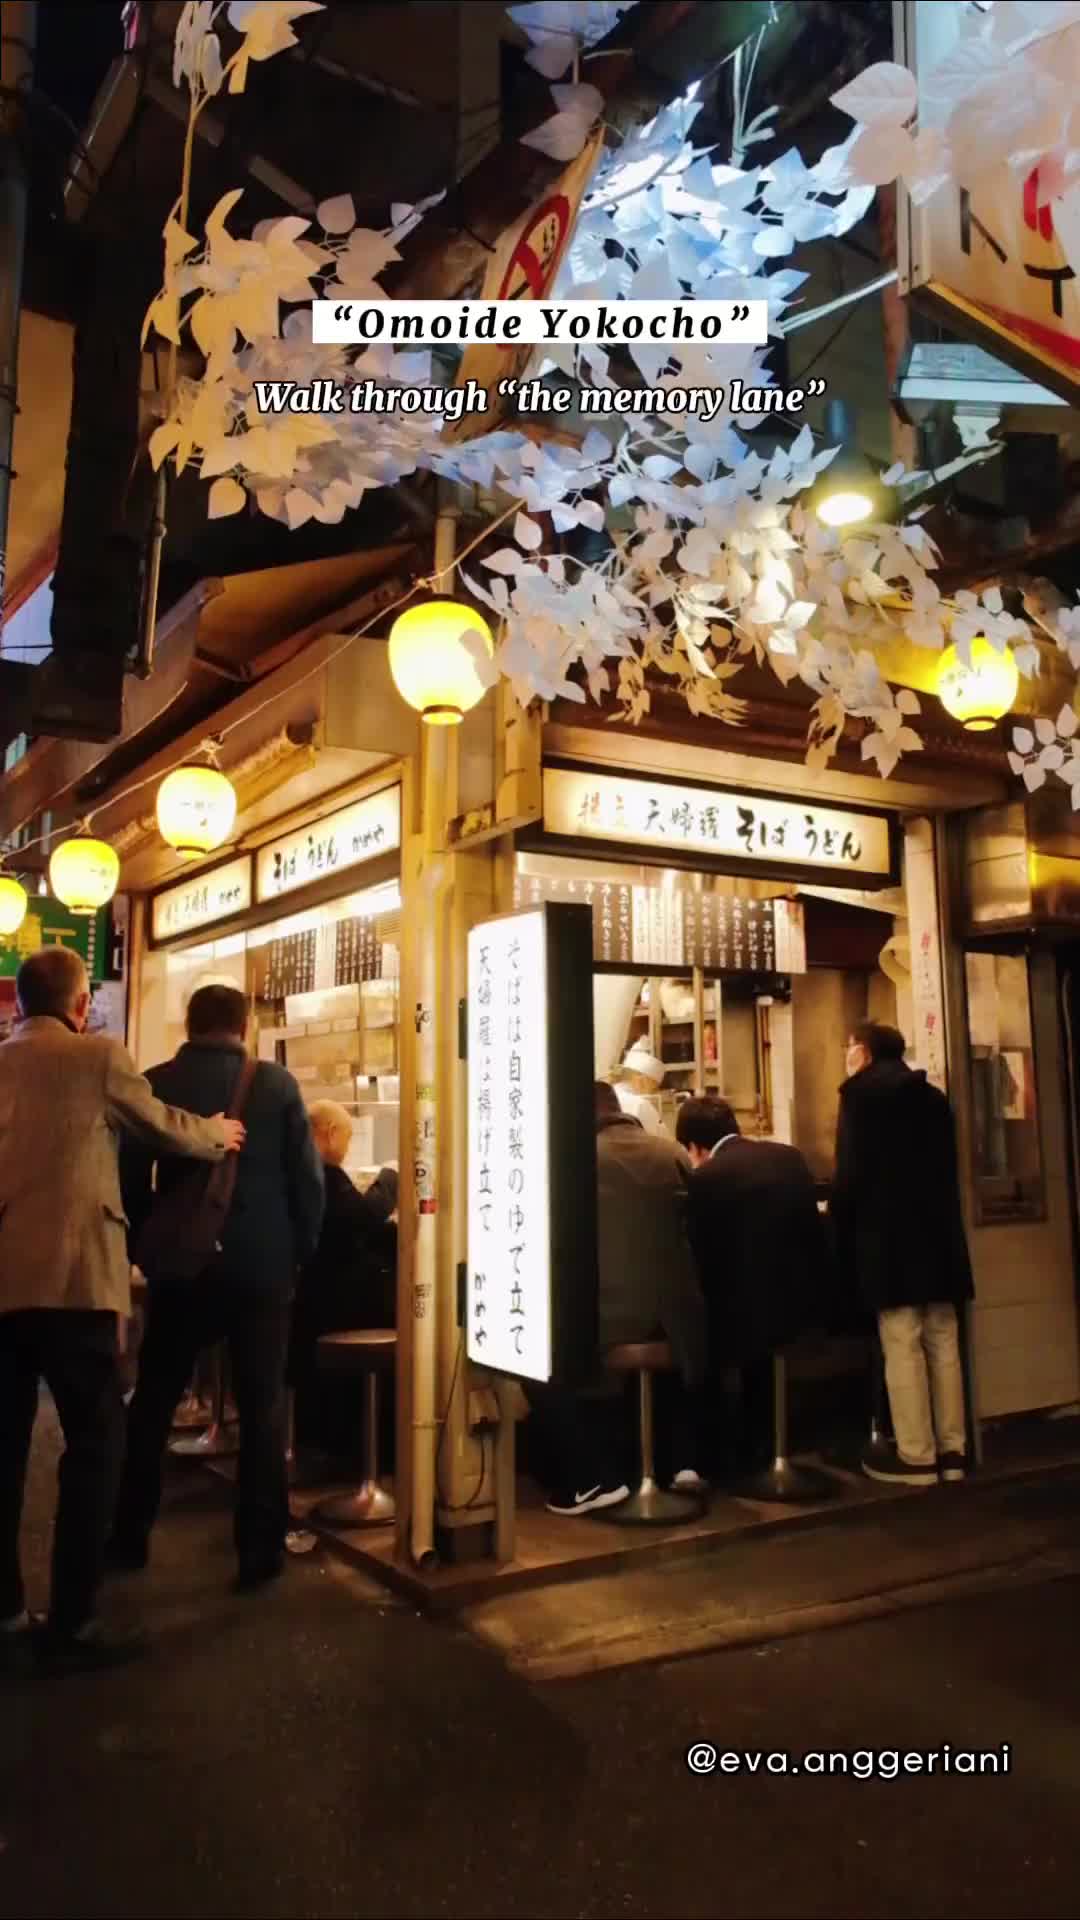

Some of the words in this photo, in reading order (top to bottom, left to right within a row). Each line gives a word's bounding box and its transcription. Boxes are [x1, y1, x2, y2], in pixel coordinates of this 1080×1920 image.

[736, 804, 789, 853] そば
[803, 813, 863, 862] うどん
